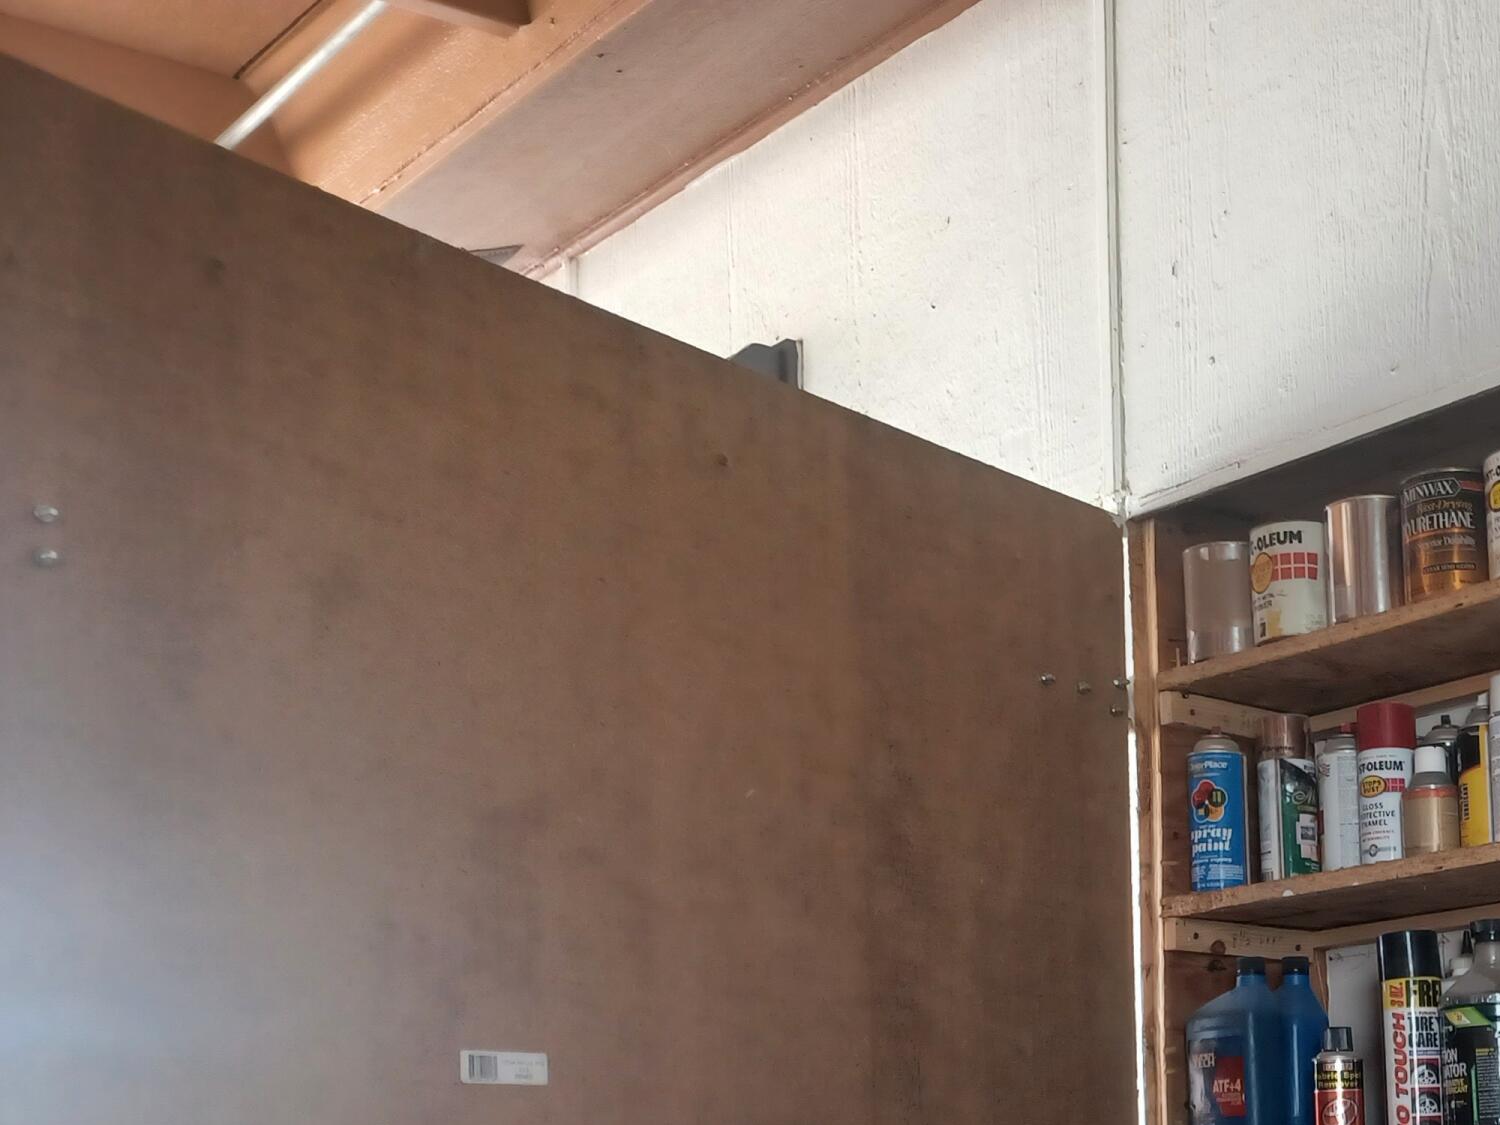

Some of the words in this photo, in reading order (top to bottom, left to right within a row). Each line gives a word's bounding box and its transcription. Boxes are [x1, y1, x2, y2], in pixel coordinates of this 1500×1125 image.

[1403, 479, 1454, 503] MINWAX
[1191, 838, 1231, 858] paint
[1407, 1015, 1435, 1032] TIRE
[1408, 1032, 1439, 1048] CARE
[1391, 1012, 1410, 1099] TOUCH
[1212, 1078, 1242, 1093] ATF+4
